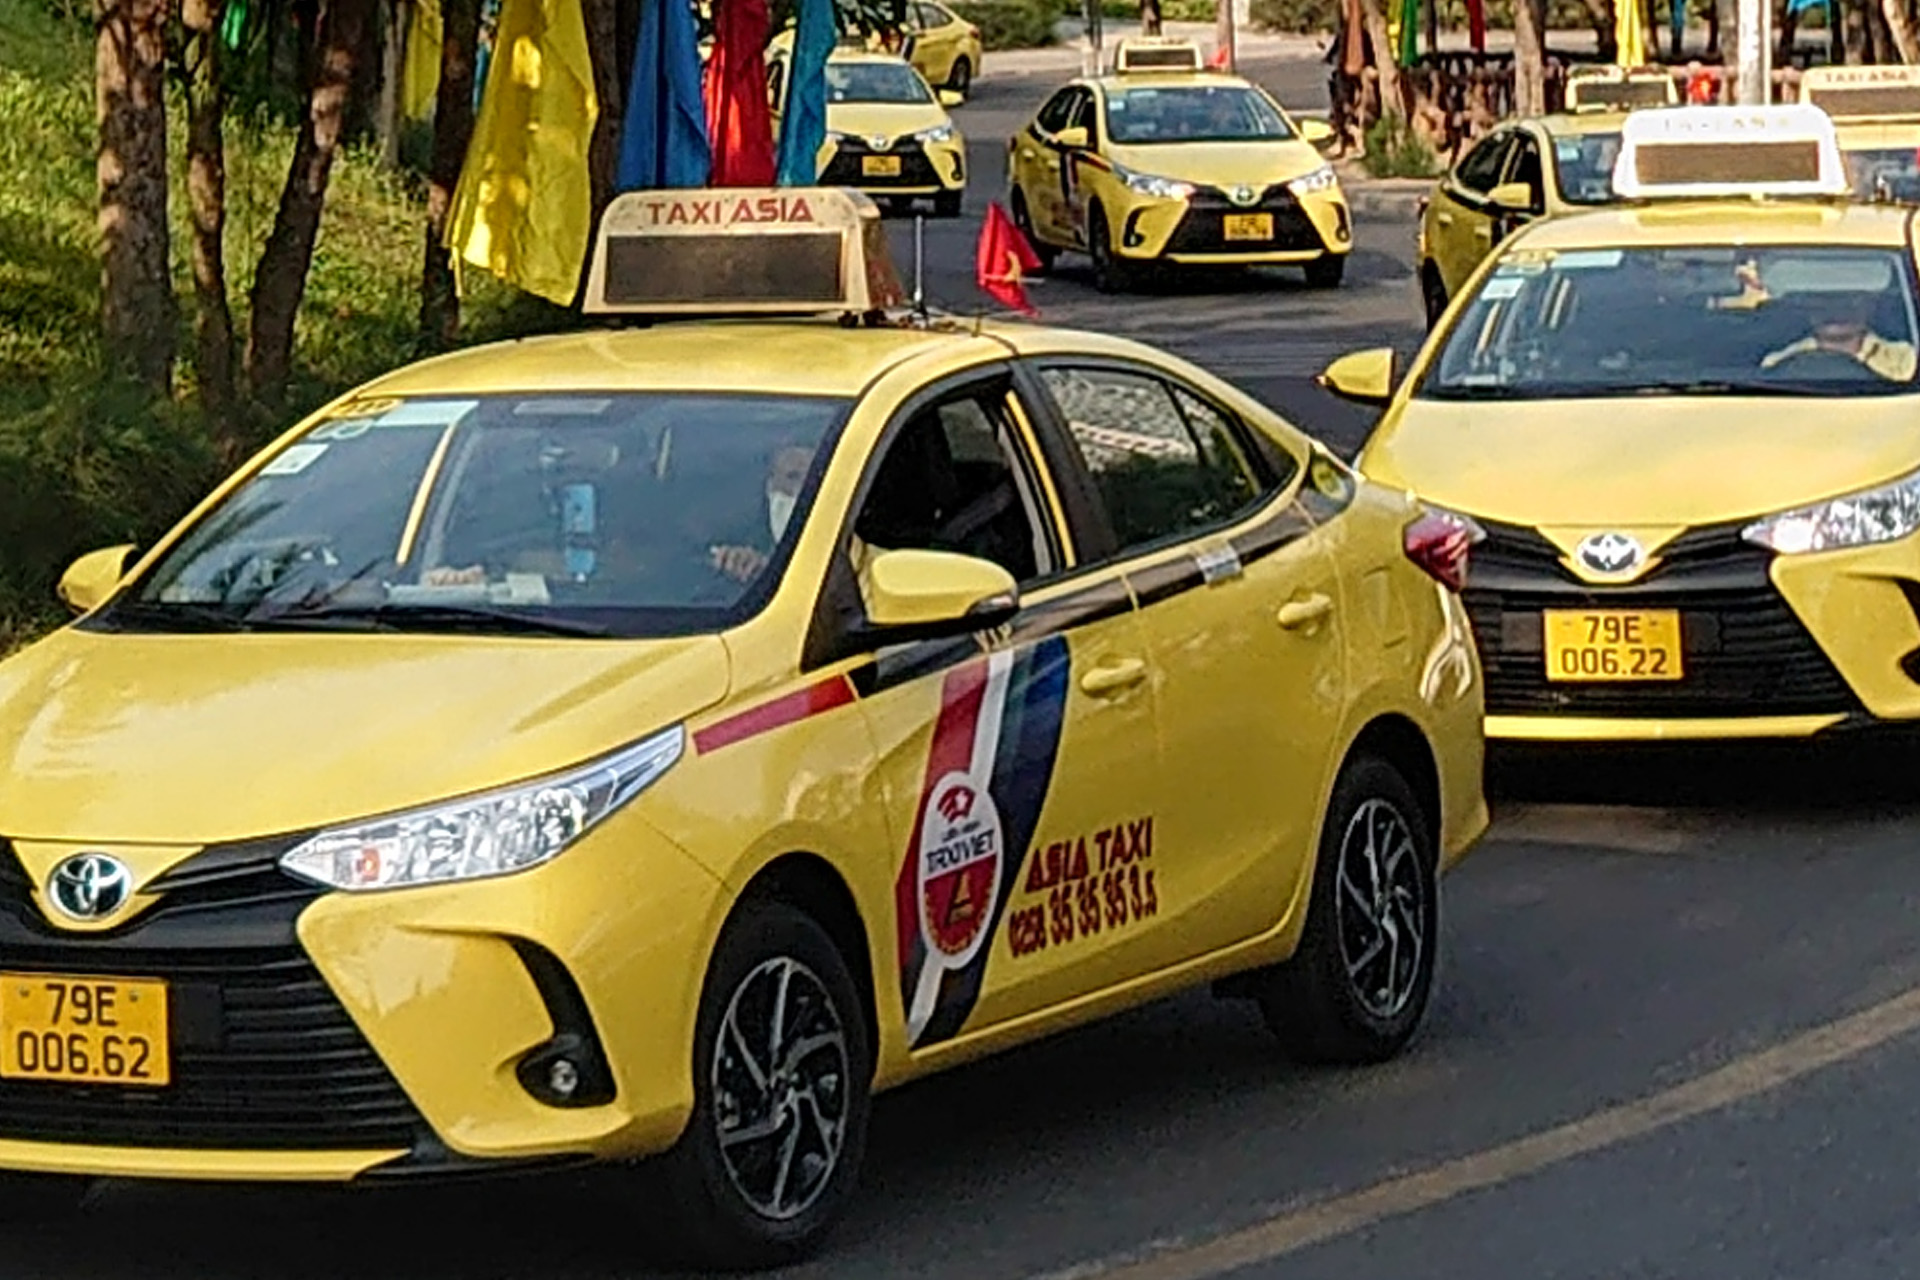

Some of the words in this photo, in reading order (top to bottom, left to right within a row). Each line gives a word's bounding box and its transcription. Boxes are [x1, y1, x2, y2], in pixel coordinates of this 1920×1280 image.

[646, 201, 721, 225] TAXI
[730, 197, 814, 223] ASIA
[1583, 615, 1643, 644] 79E
[1561, 648, 1668, 675] 006.22
[1025, 835, 1089, 893] ASIA
[1095, 816, 1152, 872] TAXI
[46, 983, 118, 1027] 79E
[18, 1031, 150, 1077] 006.62
